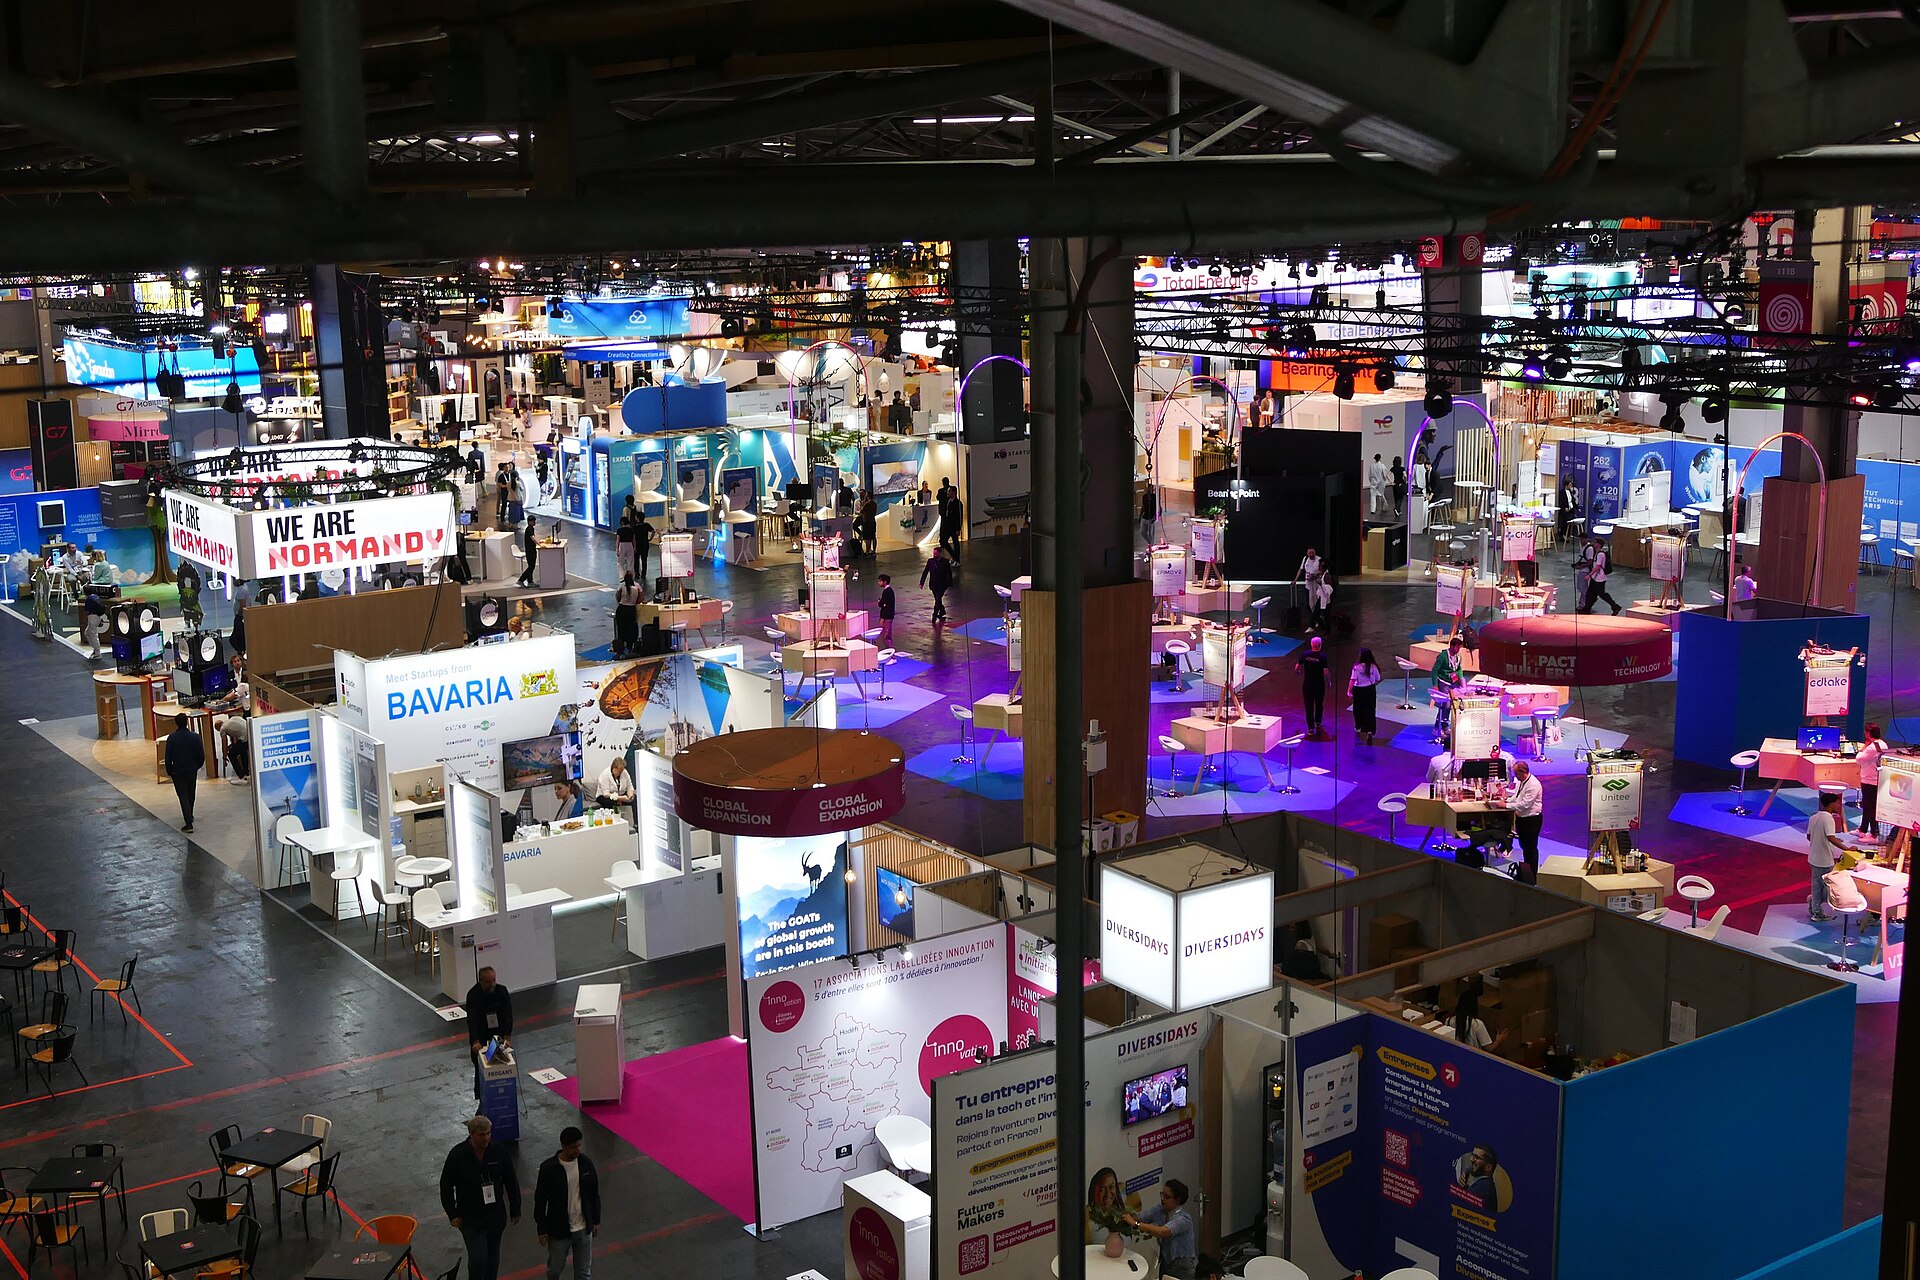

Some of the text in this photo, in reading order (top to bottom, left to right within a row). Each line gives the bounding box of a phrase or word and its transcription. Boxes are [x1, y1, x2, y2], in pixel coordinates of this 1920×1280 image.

[1163, 273, 1258, 291] TotalEnergies
[1281, 362, 1372, 379] Bearingnt
[116, 401, 134, 412] G7
[46, 426, 68, 439] G7
[1594, 456, 1610, 465] 262
[1596, 486, 1618, 496] +120
[170, 498, 184, 526] WE
[184, 503, 200, 532] ARE
[266, 510, 356, 544] WE ARE
[1514, 530, 1533, 538] CMS
[172, 526, 233, 570] NORMANDY
[268, 528, 444, 571] NORMANDY
[386, 664, 472, 684] Meet Startups from
[1614, 662, 1660, 677] TECHNOLOGY
[1810, 676, 1848, 688] edtake
[346, 699, 363, 716] Germany
[387, 676, 514, 720] BAVARIA
[262, 724, 285, 733] meet.
[263, 736, 286, 746] greet.
[263, 754, 312, 768] BAVARIA
[264, 746, 300, 757] succeed.
[702, 796, 750, 812] GLOBAL
[818, 793, 868, 811] GLOBAL
[1600, 793, 1630, 802] Unitee
[703, 810, 772, 826] EXPANSION
[818, 799, 884, 823] EXPANSION
[504, 847, 542, 862] BAVARIA
[767, 912, 821, 931] The GOATs
[766, 932, 798, 948] global
[799, 924, 835, 940] growth
[1106, 918, 1169, 956] DIVERSIDAYS
[1184, 927, 1265, 958] DIVERSIDAYS
[755, 936, 835, 962] are in this booth
[814, 938, 995, 990] 17 ASSOCIATIONS LABELLISÉES INNOVATION
[1024, 953, 1058, 978] Initiative
[814, 993, 820, 1001] 5
[821, 987, 846, 1000] d'entre
[848, 982, 864, 994] elles
[864, 979, 882, 990] sont
[884, 974, 898, 986] 100
[899, 971, 905, 980] %
[906, 966, 933, 980] dédiées
[934, 964, 939, 973] à
[940, 956, 979, 973] l'innovation
[766, 994, 787, 1006] inno
[1018, 984, 1046, 1003] LANCE
[1010, 996, 1029, 1014] AVEC
[932, 1038, 964, 1058] inno
[1118, 1022, 1198, 1058] DIVERSIDAYS
[836, 1048, 856, 1056] WILCO
[1384, 1051, 1430, 1074] Entreprises
[1385, 1068, 1442, 1095] Contribuez à faire
[1385, 1076, 1423, 1096] émerger les
[954, 1074, 1057, 1110] Tu entrepre
[1384, 1086, 1440, 1114] leaders de la tech
[955, 1098, 1036, 1126] dans la tech et
[1309, 1101, 1320, 1110] CGI
[1411, 1106, 1450, 1126] Diversidays
[956, 1116, 1036, 1145] Rejoins l'aventure
[1156, 1132, 1166, 1140] on
[1166, 1123, 1190, 1137] parlait
[956, 1137, 1006, 1159] partout en
[1140, 1144, 1155, 1153] des
[1156, 1132, 1187, 1148] solutions
[978, 1140, 1056, 1172] programmes gratuits
[972, 1176, 988, 1187] pour
[989, 1163, 1038, 1182] t'accompagner
[1383, 1168, 1416, 1186] Découvrez
[968, 1176, 1020, 1196] développement
[1020, 1174, 1028, 1182] de
[1383, 1176, 1420, 1195] une nouvelle
[1383, 1182, 1415, 1200] génération
[1392, 1192, 1412, 1205] talents
[958, 1201, 995, 1218] Future
[958, 1209, 1004, 1230] Makers
[858, 1223, 880, 1247] inno
[996, 1225, 1030, 1241] Découvre
[996, 1224, 1054, 1248] nos programmes
[876, 1247, 896, 1266] vation
